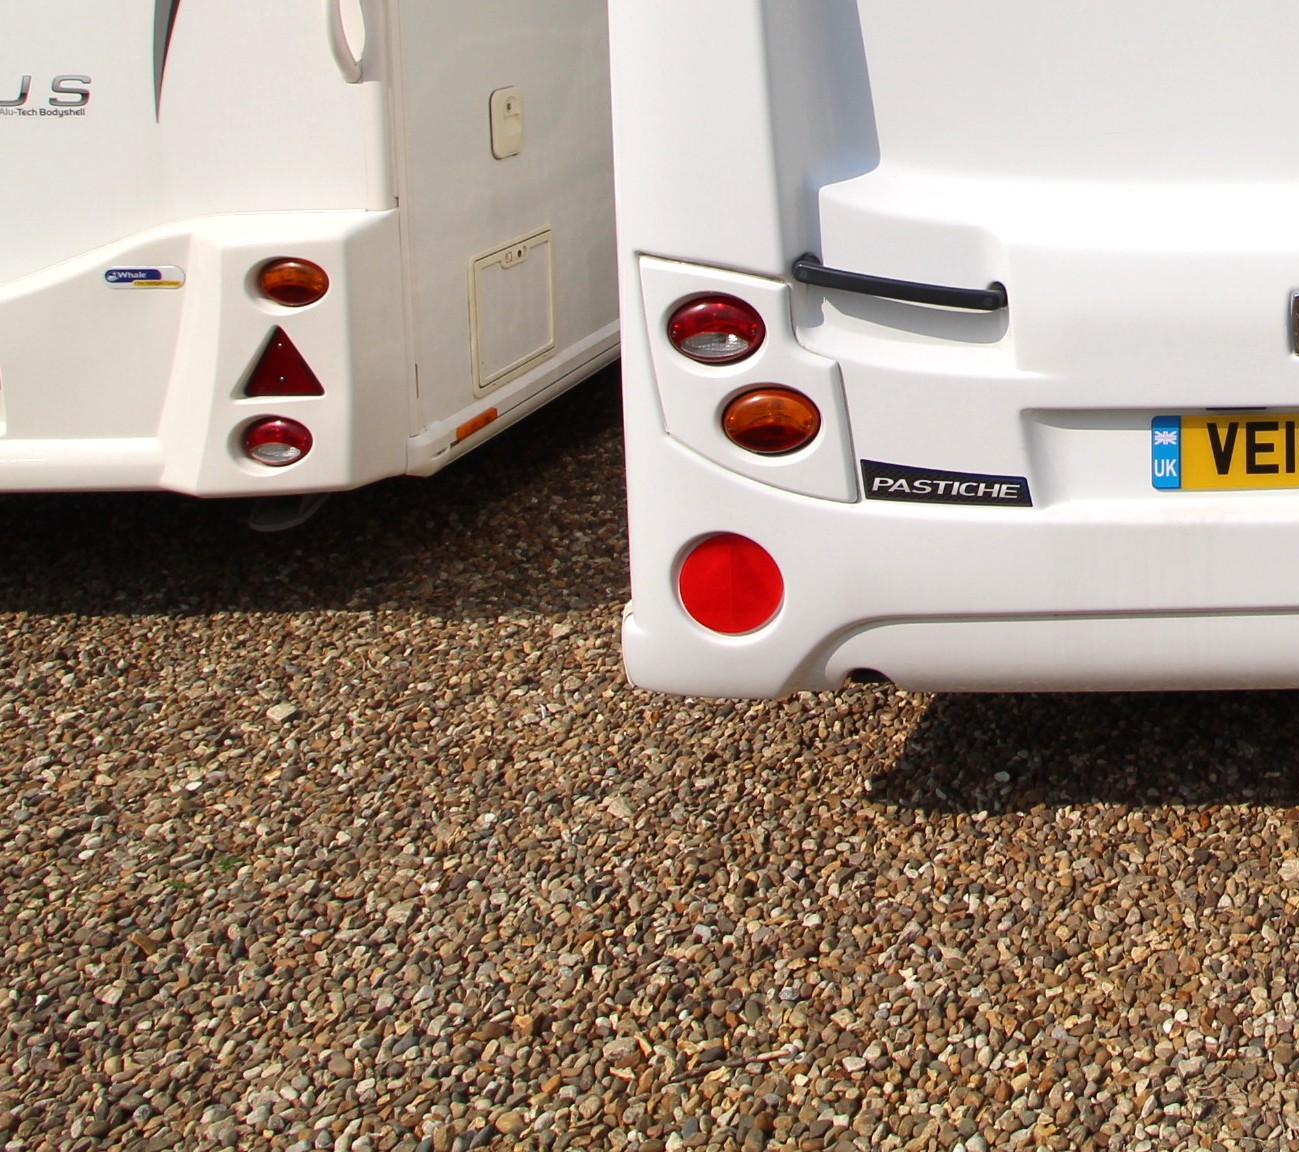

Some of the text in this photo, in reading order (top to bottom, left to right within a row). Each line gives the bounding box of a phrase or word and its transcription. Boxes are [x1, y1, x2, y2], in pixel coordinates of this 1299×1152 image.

[39, 108, 86, 118] Bodyshell
[119, 271, 147, 279] Whale
[1154, 459, 1177, 477] UK
[871, 477, 1021, 498] PASTICHE
